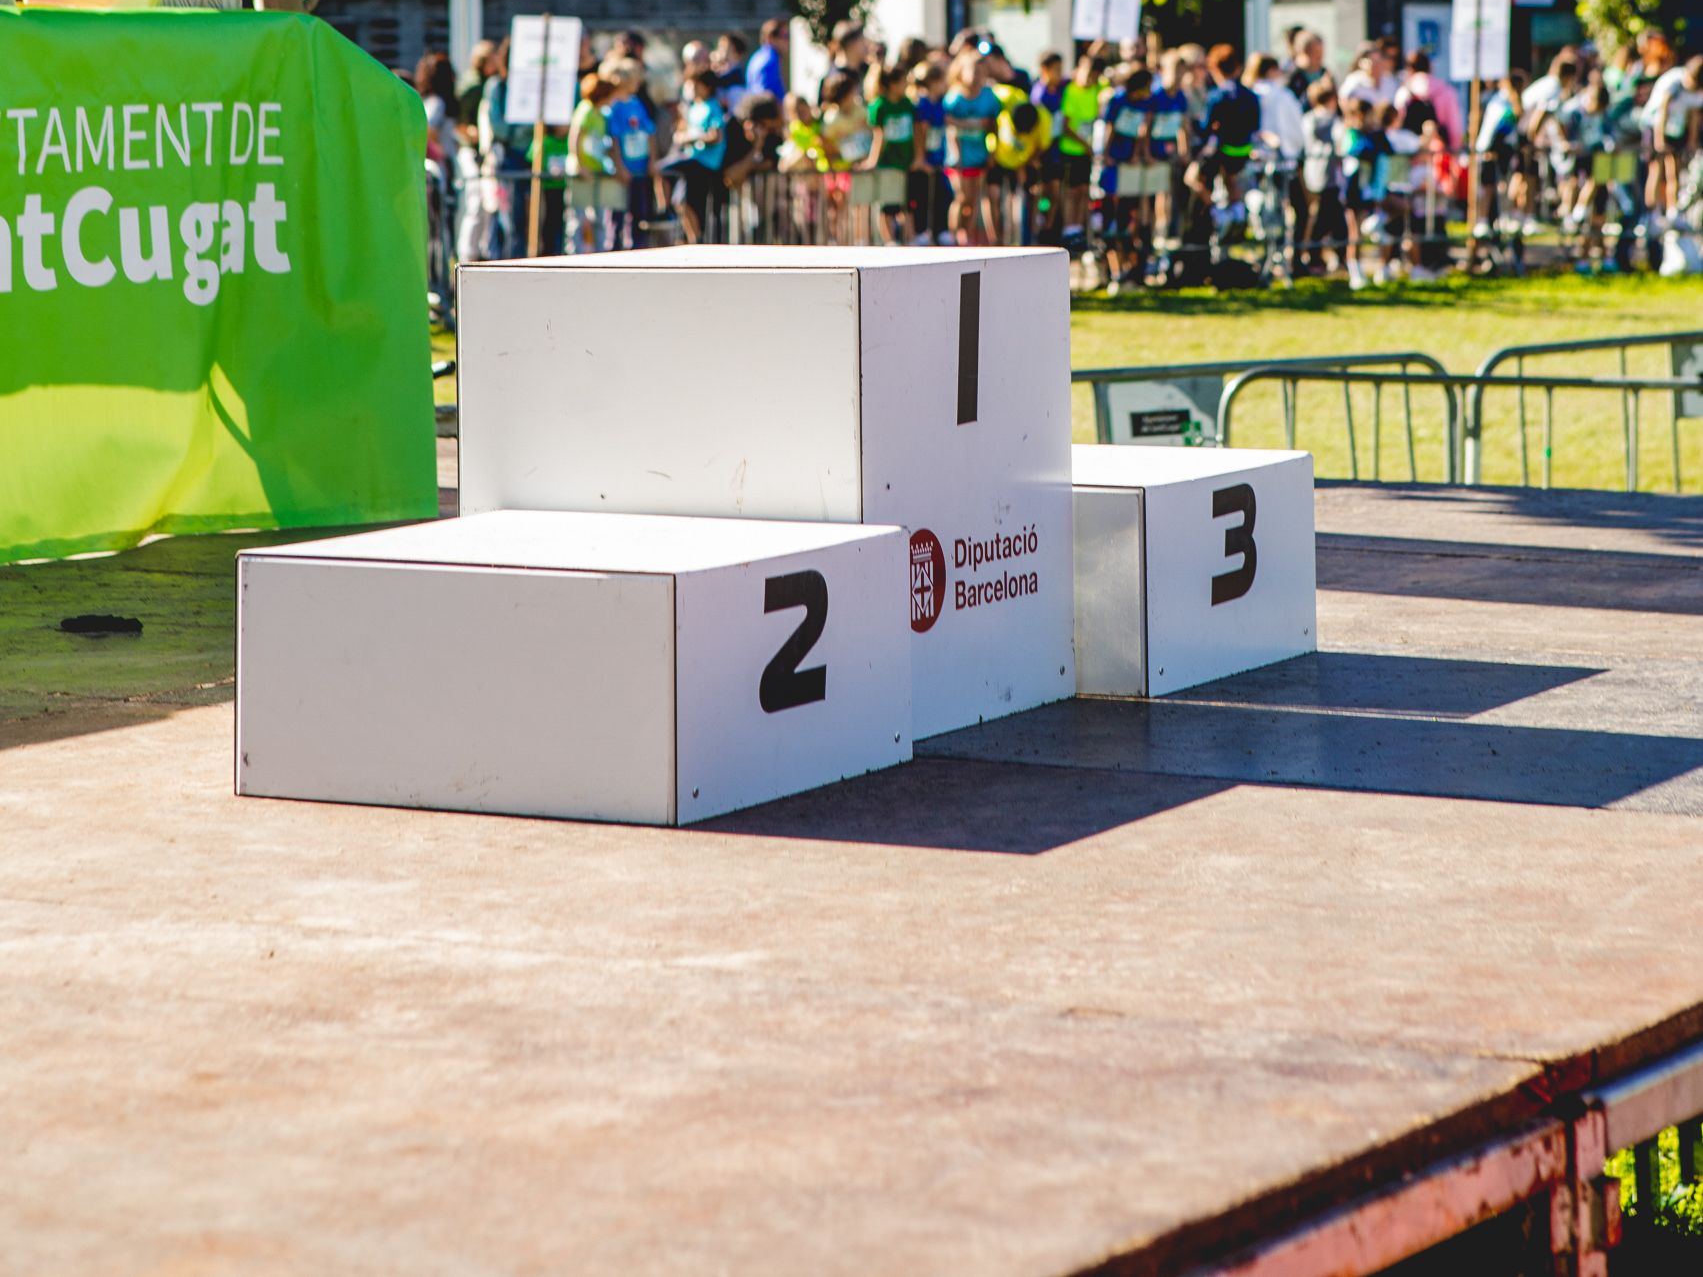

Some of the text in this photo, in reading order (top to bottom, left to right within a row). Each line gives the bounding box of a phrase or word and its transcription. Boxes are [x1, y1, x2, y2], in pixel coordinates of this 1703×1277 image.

[956, 270, 981, 426] 1
[954, 523, 1038, 572] Diputació
[954, 570, 1038, 611] Barcelona
[1210, 483, 1258, 607] 3
[758, 569, 829, 714] 2
